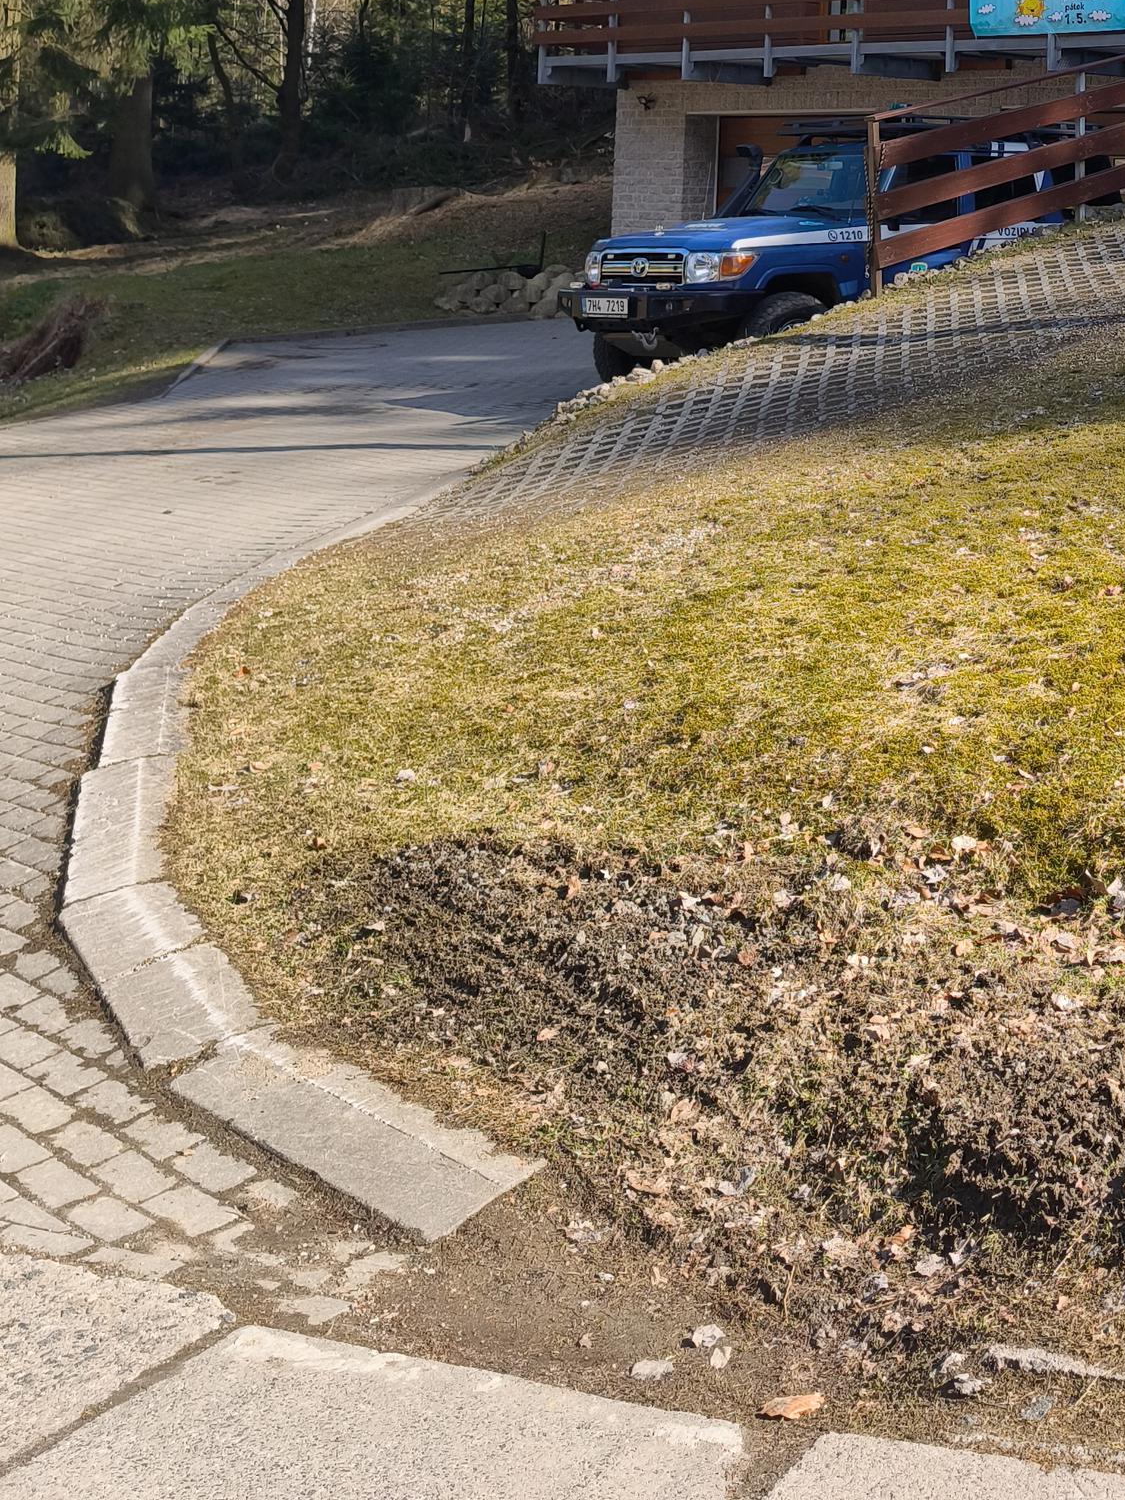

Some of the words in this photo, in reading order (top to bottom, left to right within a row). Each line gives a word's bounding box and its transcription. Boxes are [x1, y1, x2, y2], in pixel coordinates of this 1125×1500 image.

[1065, 1, 1084, 13] pátek
[839, 230, 863, 240] 1210
[588, 300, 602, 312] 7H4
[606, 300, 625, 312] 7219
